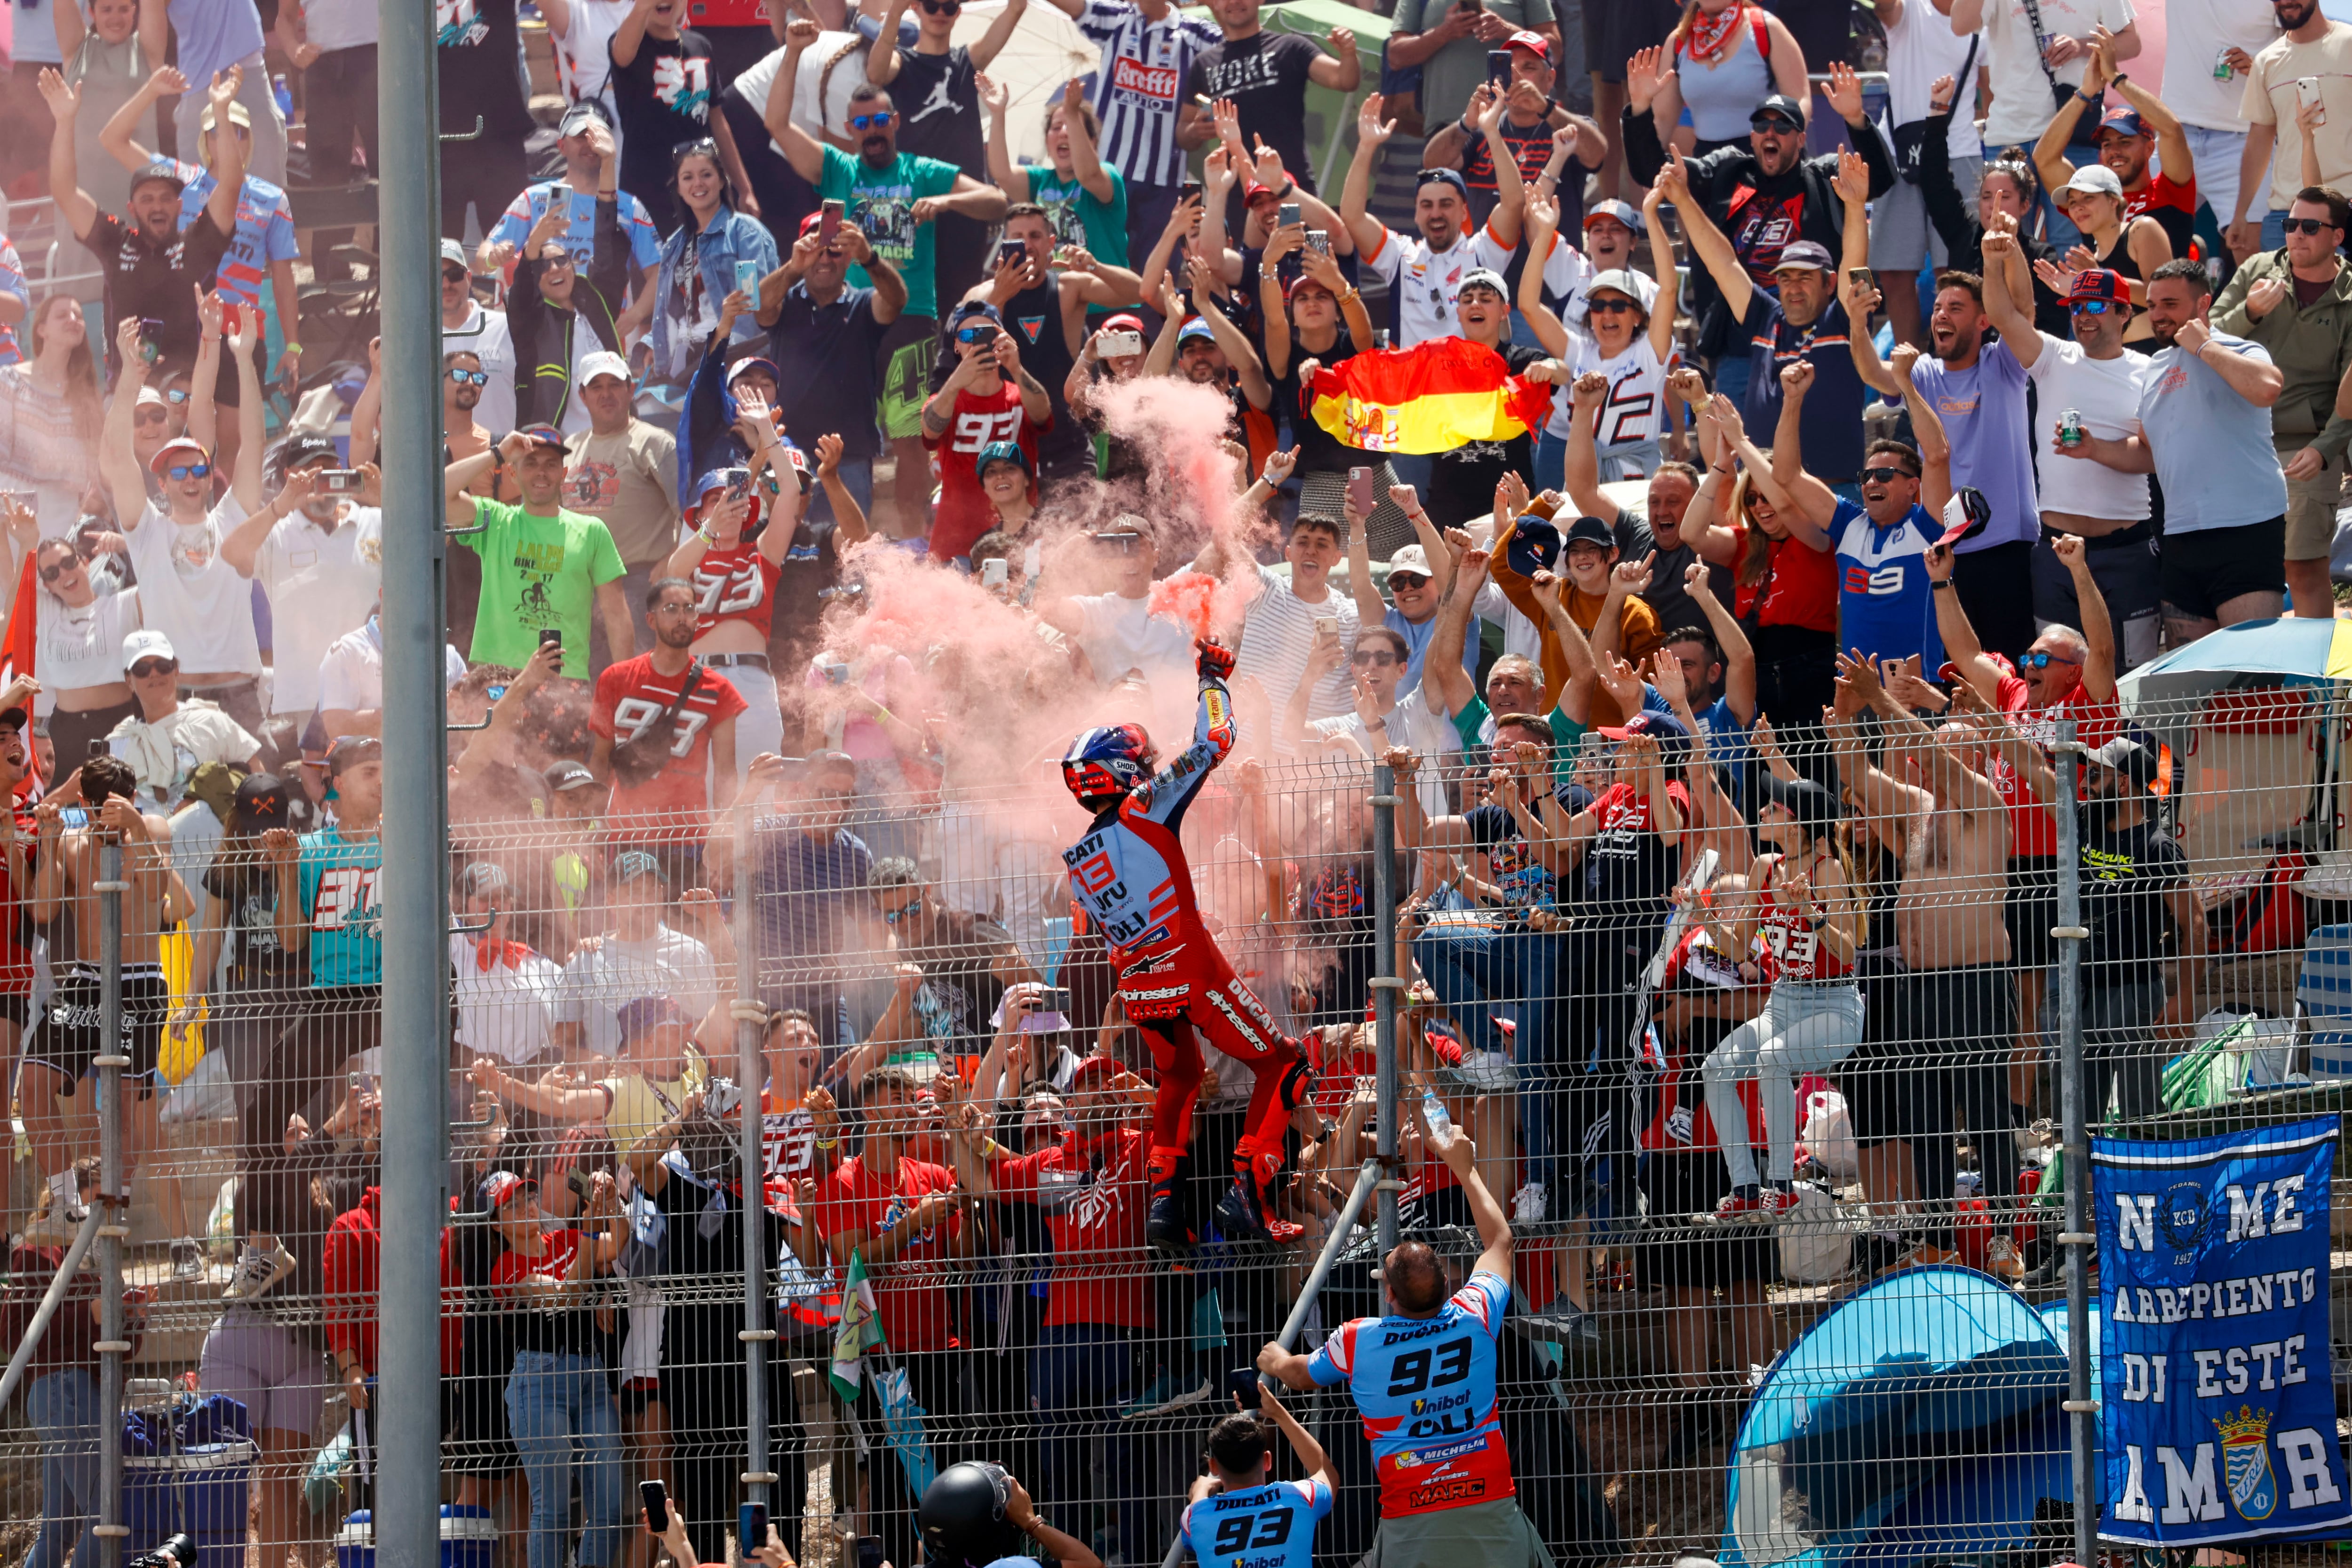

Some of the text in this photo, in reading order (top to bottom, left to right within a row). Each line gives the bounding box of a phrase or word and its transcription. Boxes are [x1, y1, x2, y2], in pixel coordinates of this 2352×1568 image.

[1116, 60, 1175, 96] Krefft
[1206, 51, 1278, 93] WOKE
[1120, 92, 1163, 111] AUTO
[1908, 143, 1922, 166] NY
[1941, 400, 1977, 412] adidas
[952, 406, 1023, 453] 93
[1118, 516, 1132, 527] NY
[514, 557, 536, 569] BIKE
[1401, 549, 1417, 564] M
[542, 573, 553, 584] 17
[693, 563, 761, 614] 93
[1211, 690, 1221, 725] Antangin
[614, 697, 708, 758] 93
[1116, 761, 1136, 772] SHOEI
[1764, 924, 1819, 962] 93
[1120, 983, 1190, 1002] alpinestars
[1205, 989, 1267, 1052] alpinestars
[1227, 978, 1282, 1041] DUCATI
[2168, 1181, 2201, 1192] PEDANIAS
[2115, 1174, 2305, 1252] N ME
[2173, 1209, 2196, 1226] XCD
[2174, 1252, 2193, 1266] 1947
[1383, 1319, 1463, 1346] DUCATI
[1387, 1336, 1472, 1397] 93
[2194, 1334, 2307, 1399] ESTE
[1410, 1389, 1471, 1417] Unibat
[1423, 1438, 1485, 1460] MICHELIN
[1421, 1471, 1470, 1486] alpinestars
[2234, 1448, 2265, 1503] XEREZ
[1215, 1488, 1281, 1512] DUCATI
[1410, 1478, 1485, 1509] MARC
[1214, 1507, 1294, 1556] 93
[1231, 1554, 1287, 1568] Unibat
